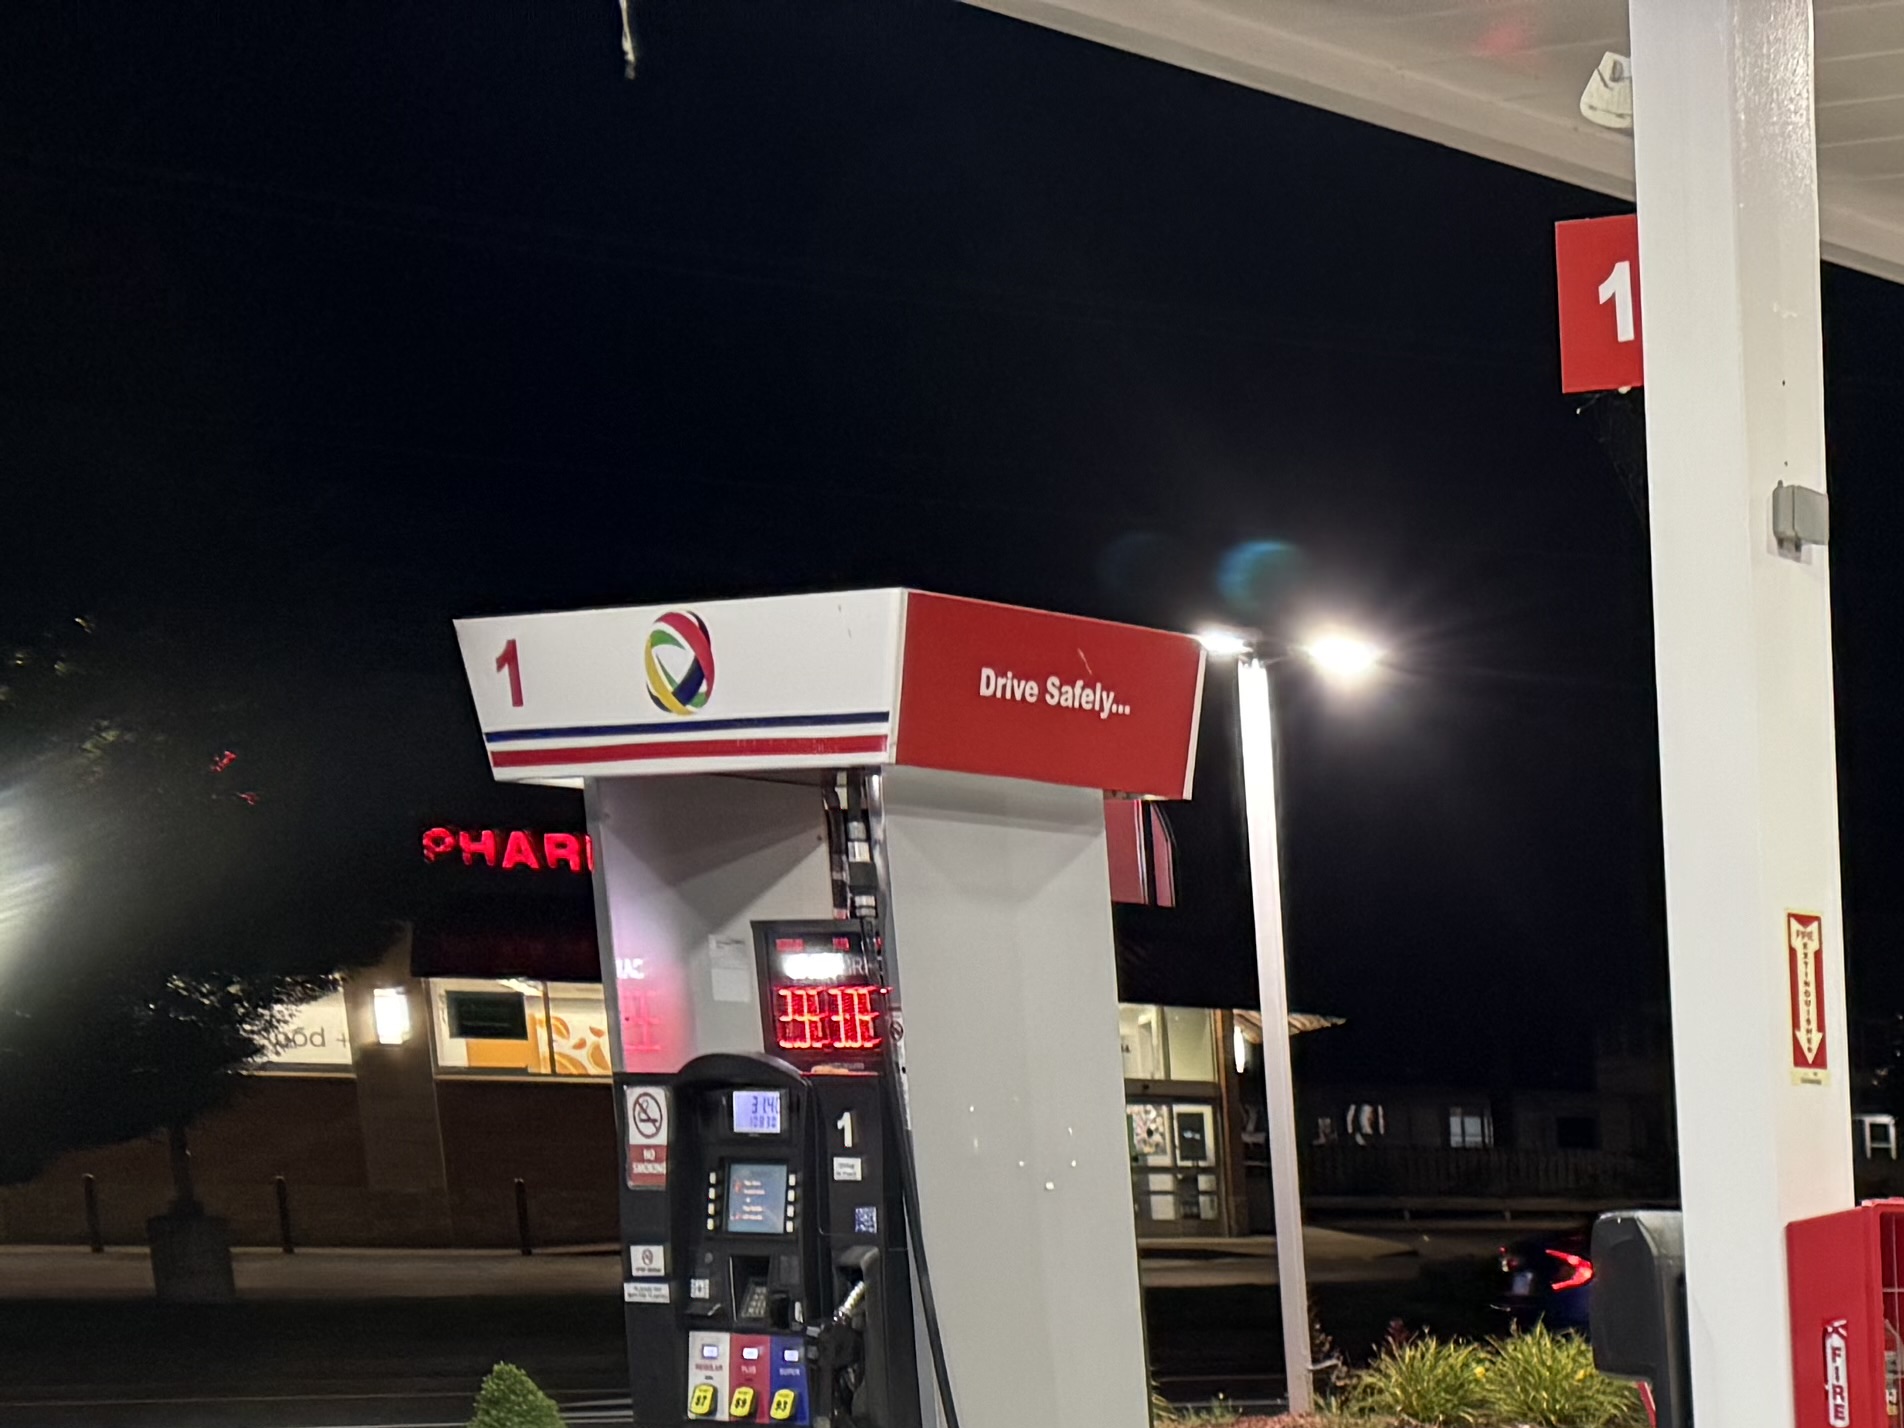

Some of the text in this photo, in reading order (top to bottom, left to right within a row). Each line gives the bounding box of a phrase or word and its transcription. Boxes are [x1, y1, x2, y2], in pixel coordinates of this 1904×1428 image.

[1598, 261, 1634, 342] 1
[495, 639, 524, 708] 1
[980, 667, 1039, 703] Drive
[422, 827, 594, 872] PHAR
[837, 1111, 852, 1147] 1
[643, 1148, 656, 1162] NO
[1832, 1346, 1846, 1421] FIRE
